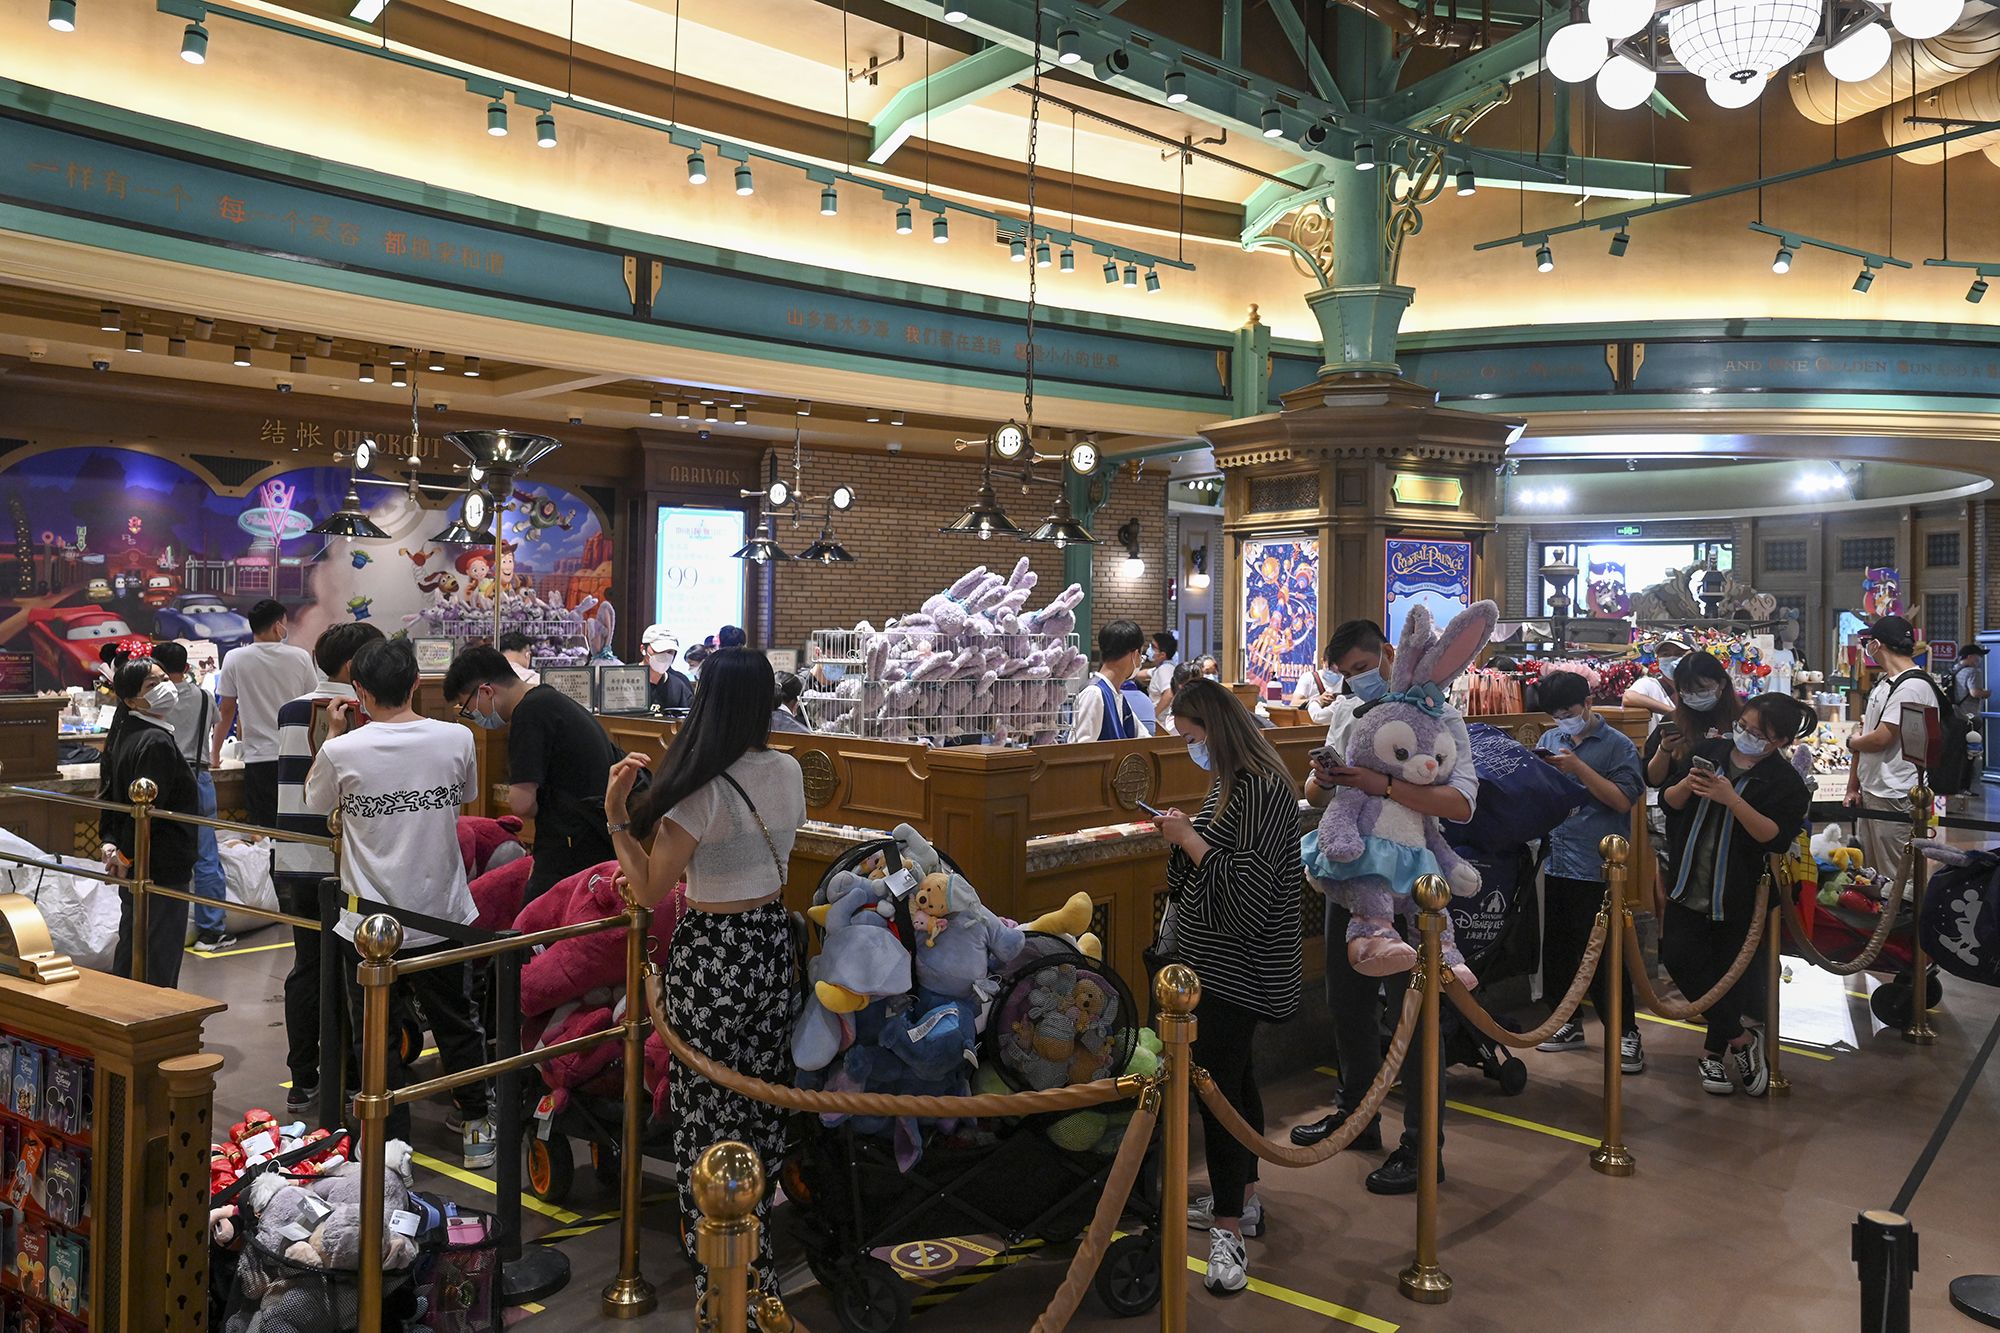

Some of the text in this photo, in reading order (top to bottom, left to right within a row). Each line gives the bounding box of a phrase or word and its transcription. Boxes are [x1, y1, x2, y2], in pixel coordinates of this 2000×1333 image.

[1723, 359, 1762, 372] AND
[1815, 356, 1887, 373] GOLDEN
[260, 419, 324, 448] 结帐
[1002, 435, 1019, 448] 13
[1077, 452, 1093, 465] 12
[670, 465, 740, 486] ARRIVALS
[667, 565, 698, 589] 99
